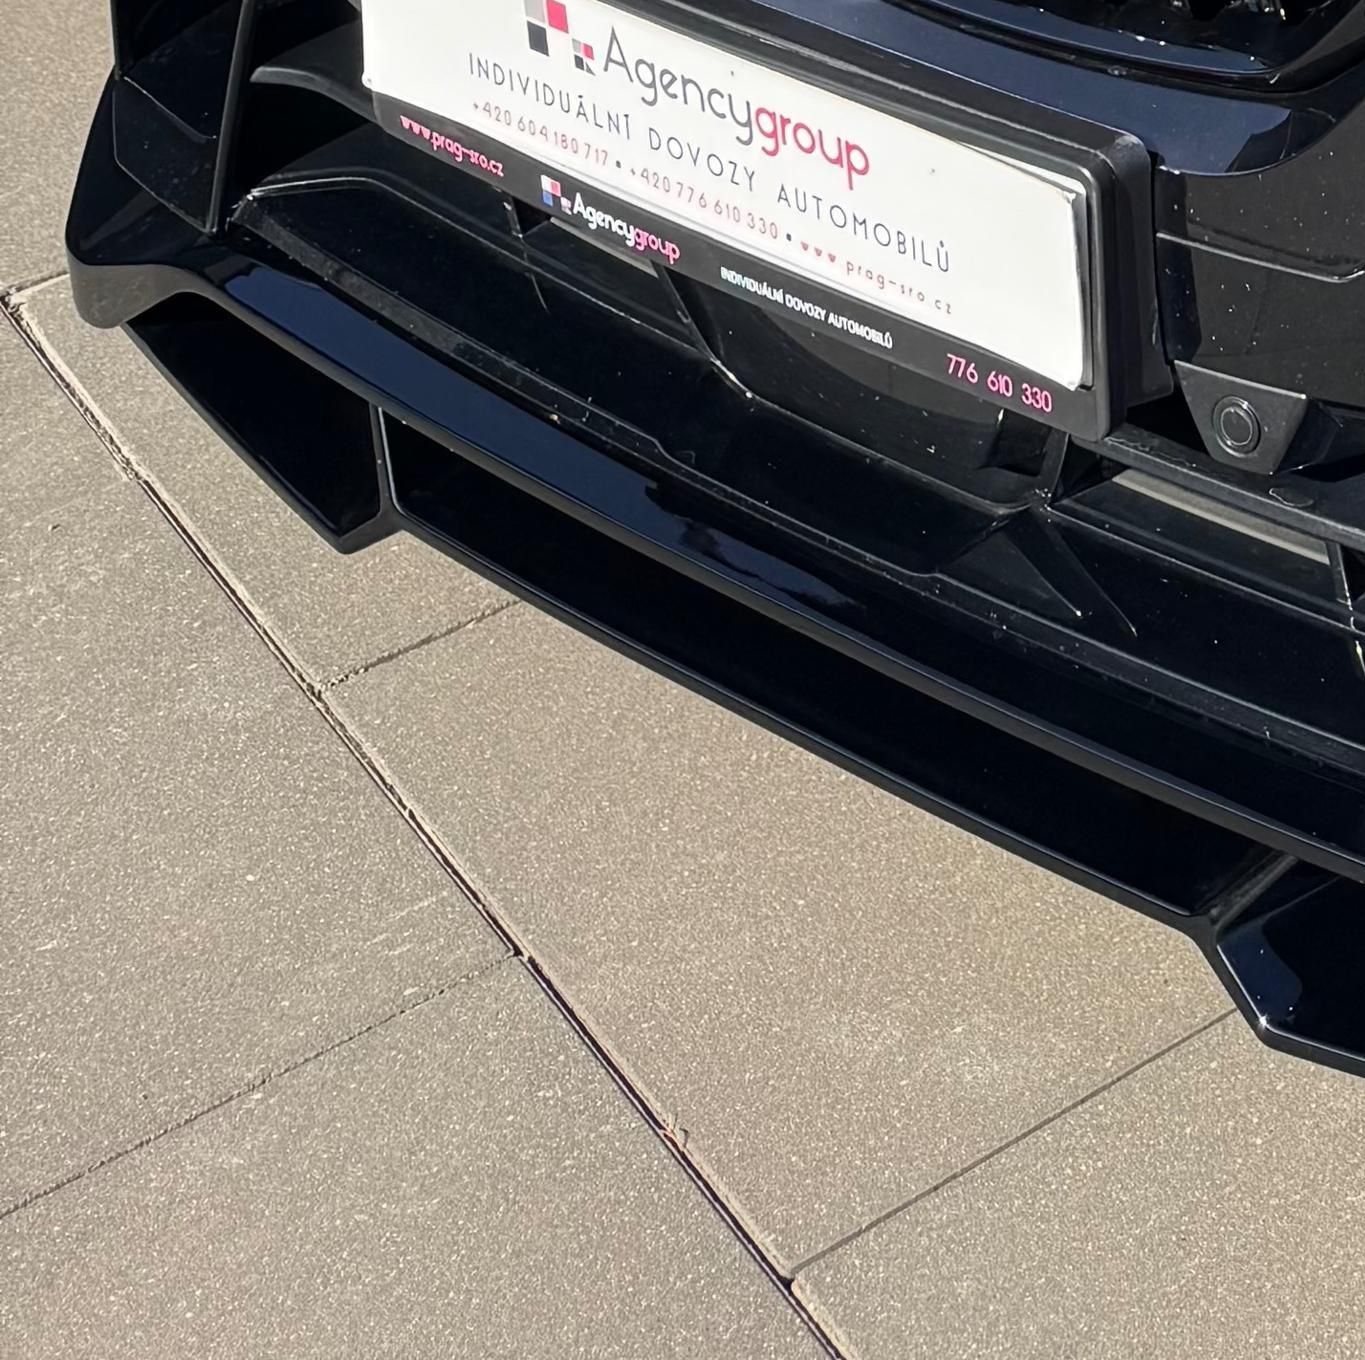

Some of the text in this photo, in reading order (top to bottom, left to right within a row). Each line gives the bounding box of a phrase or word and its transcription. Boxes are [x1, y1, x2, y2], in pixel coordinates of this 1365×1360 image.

[603, 25, 870, 190] Agencygroup
[400, 115, 505, 177] www.prag-sro.cz
[469, 52, 950, 273] INDIVIDUÁLNÍ DOVOZY AUTOMOBILŮ
[572, 192, 681, 264] Agencygroup
[747, 212, 779, 239] 330
[785, 294, 827, 322] DOVOZY
[947, 353, 1053, 413] 776 610 330
